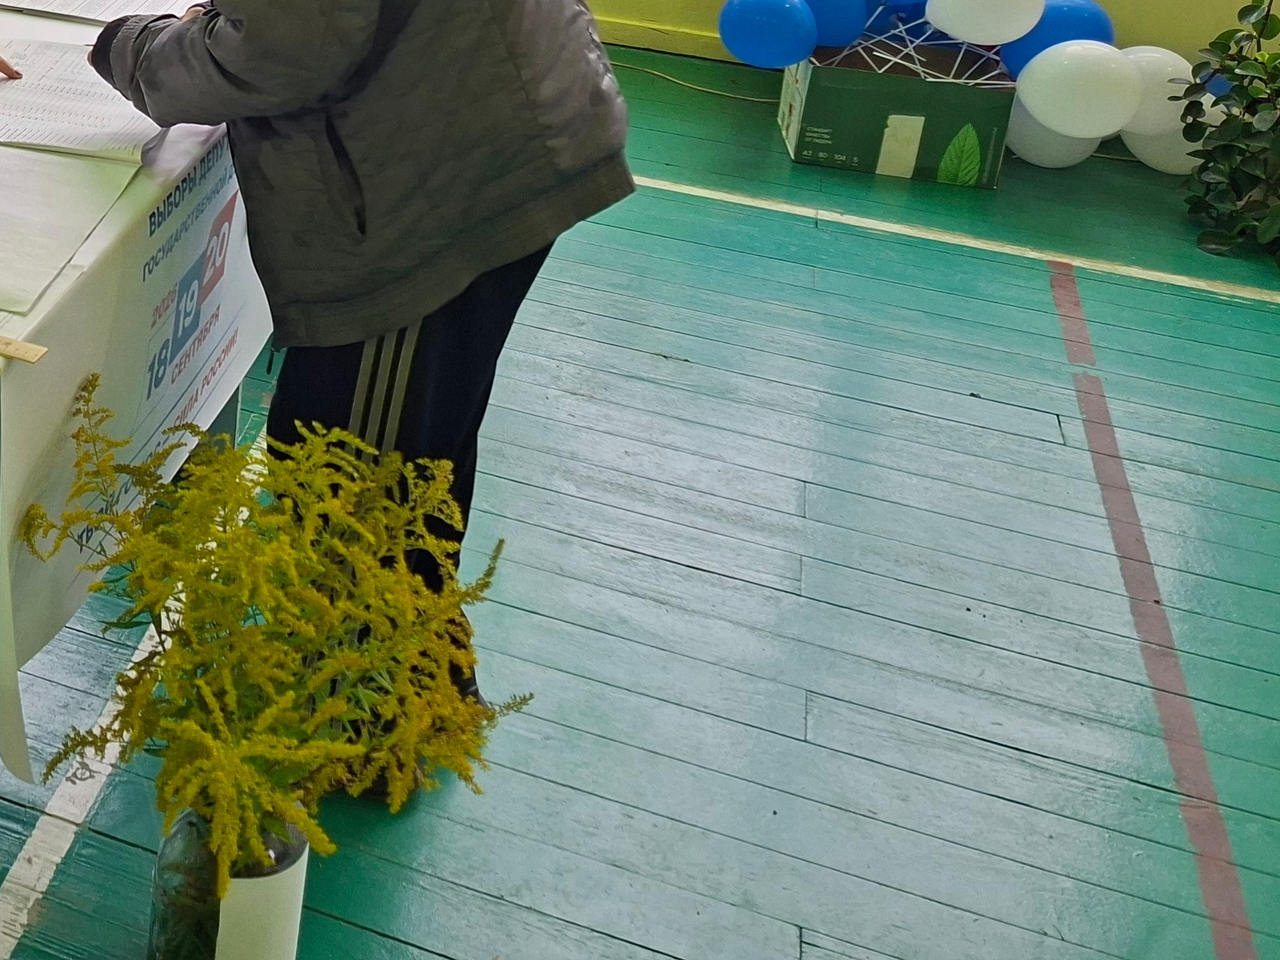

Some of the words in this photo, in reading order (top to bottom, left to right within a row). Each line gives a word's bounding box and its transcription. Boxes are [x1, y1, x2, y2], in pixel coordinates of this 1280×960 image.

[142, 167, 227, 283] ГОСУДАРСТВЕННОЙ
[148, 168, 197, 238] ВЫБОРЫ
[202, 221, 230, 289] 20
[177, 279, 199, 338] 19
[146, 338, 171, 401] 18
[170, 304, 221, 385] СЕНТЯБРЯ
[200, 327, 239, 396] РОССИИ!
